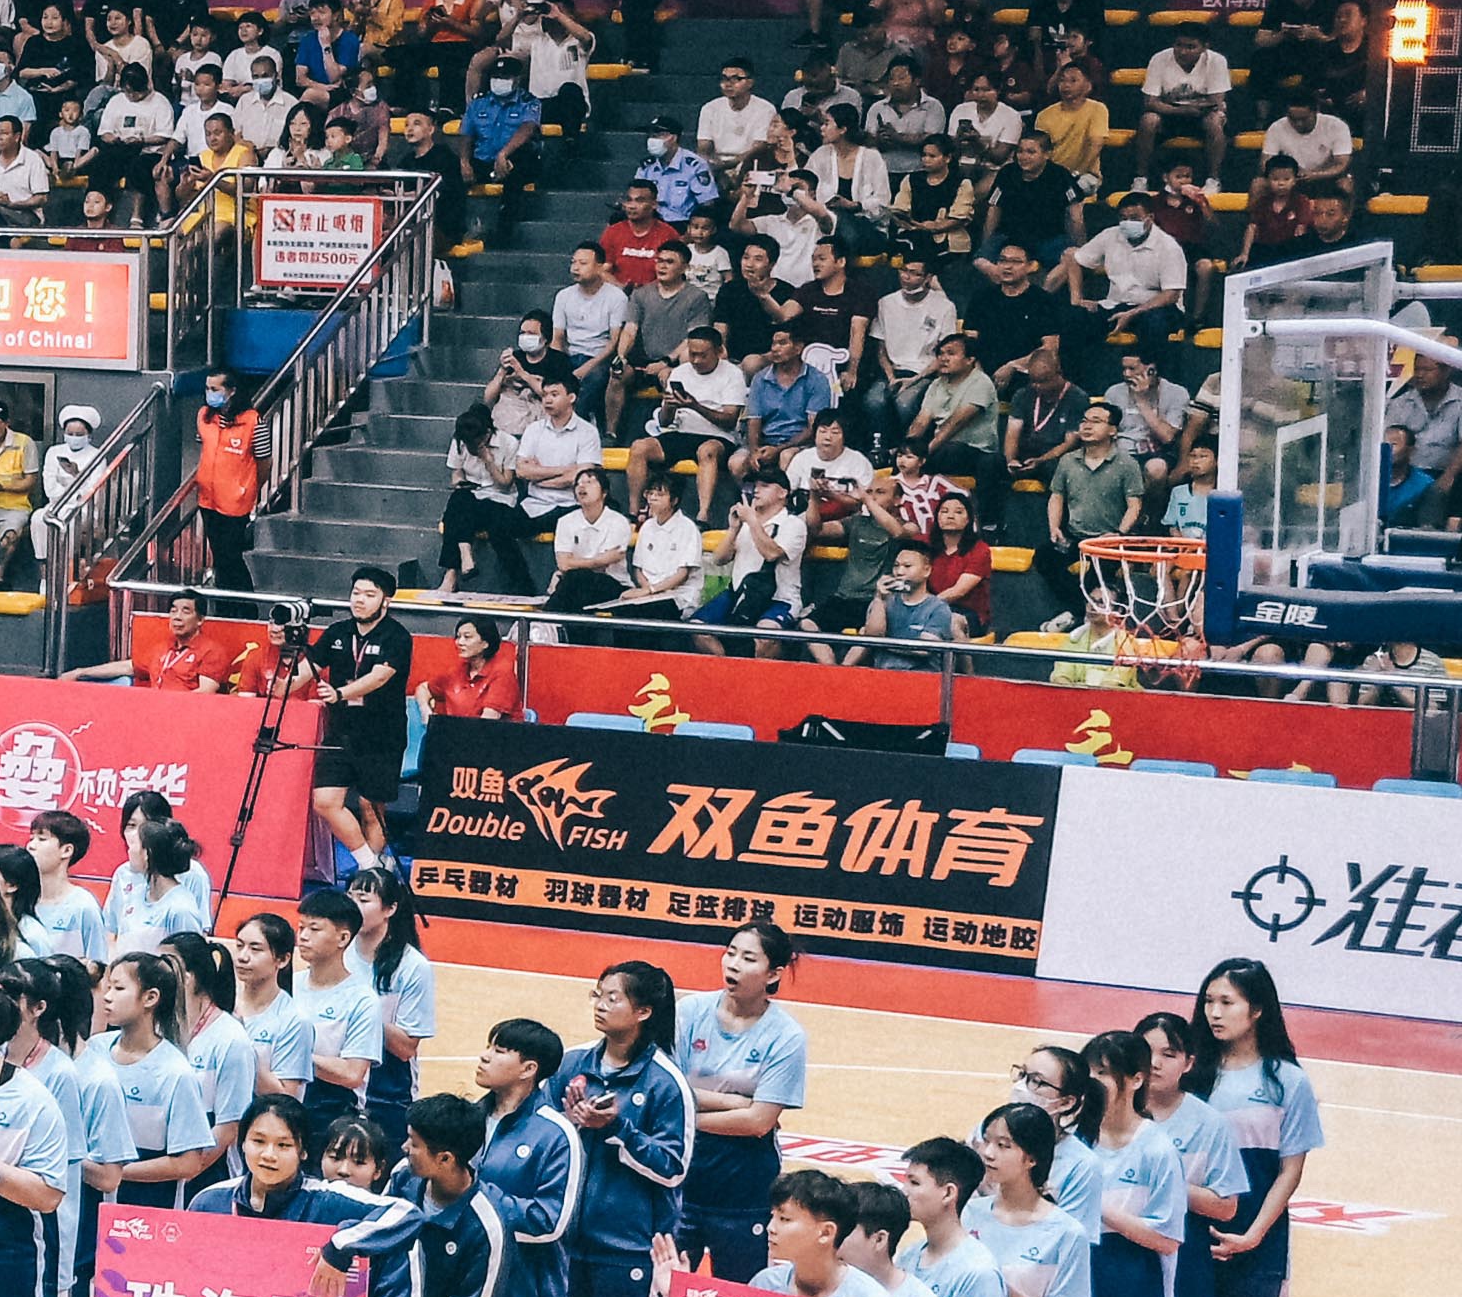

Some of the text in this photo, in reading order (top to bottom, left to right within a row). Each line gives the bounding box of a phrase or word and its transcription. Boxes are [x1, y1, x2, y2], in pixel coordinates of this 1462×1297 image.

[299, 212, 364, 235] 禁止吸烟
[5, 327, 25, 347] of
[1253, 600, 1318, 627] 金陵
[426, 807, 630, 853] Double FISH
[647, 782, 1046, 889] 双鱼体育
[415, 865, 1039, 954] 乒乓器材 羽球器材 足篮排球 运动服饰 运动地胶
